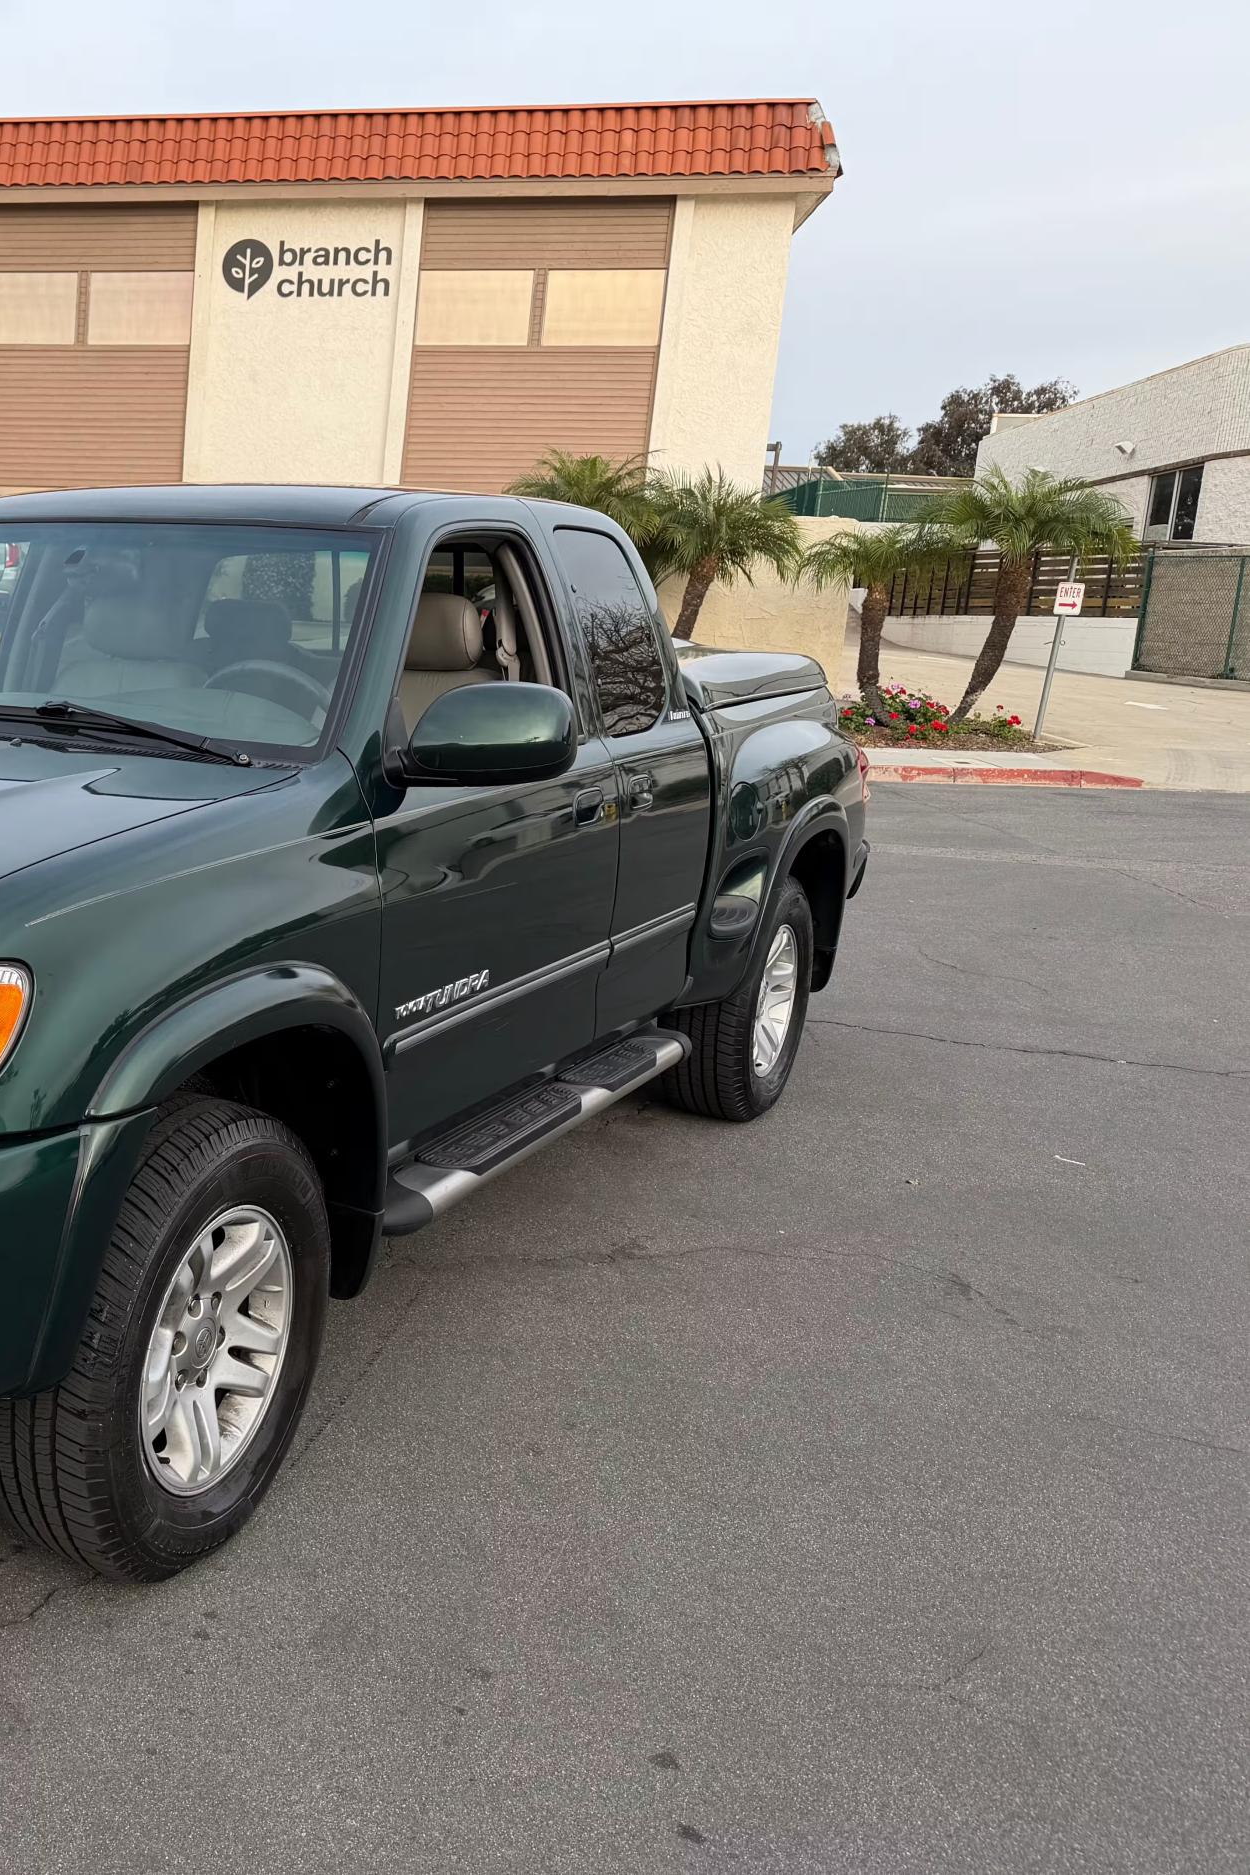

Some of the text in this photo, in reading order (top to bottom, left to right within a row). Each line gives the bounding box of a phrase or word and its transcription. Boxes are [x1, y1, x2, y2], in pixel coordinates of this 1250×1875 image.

[278, 239, 393, 267] branch
[276, 270, 391, 298] church
[1059, 586, 1081, 598] ENTER
[423, 969, 490, 1013] TUNDRA
